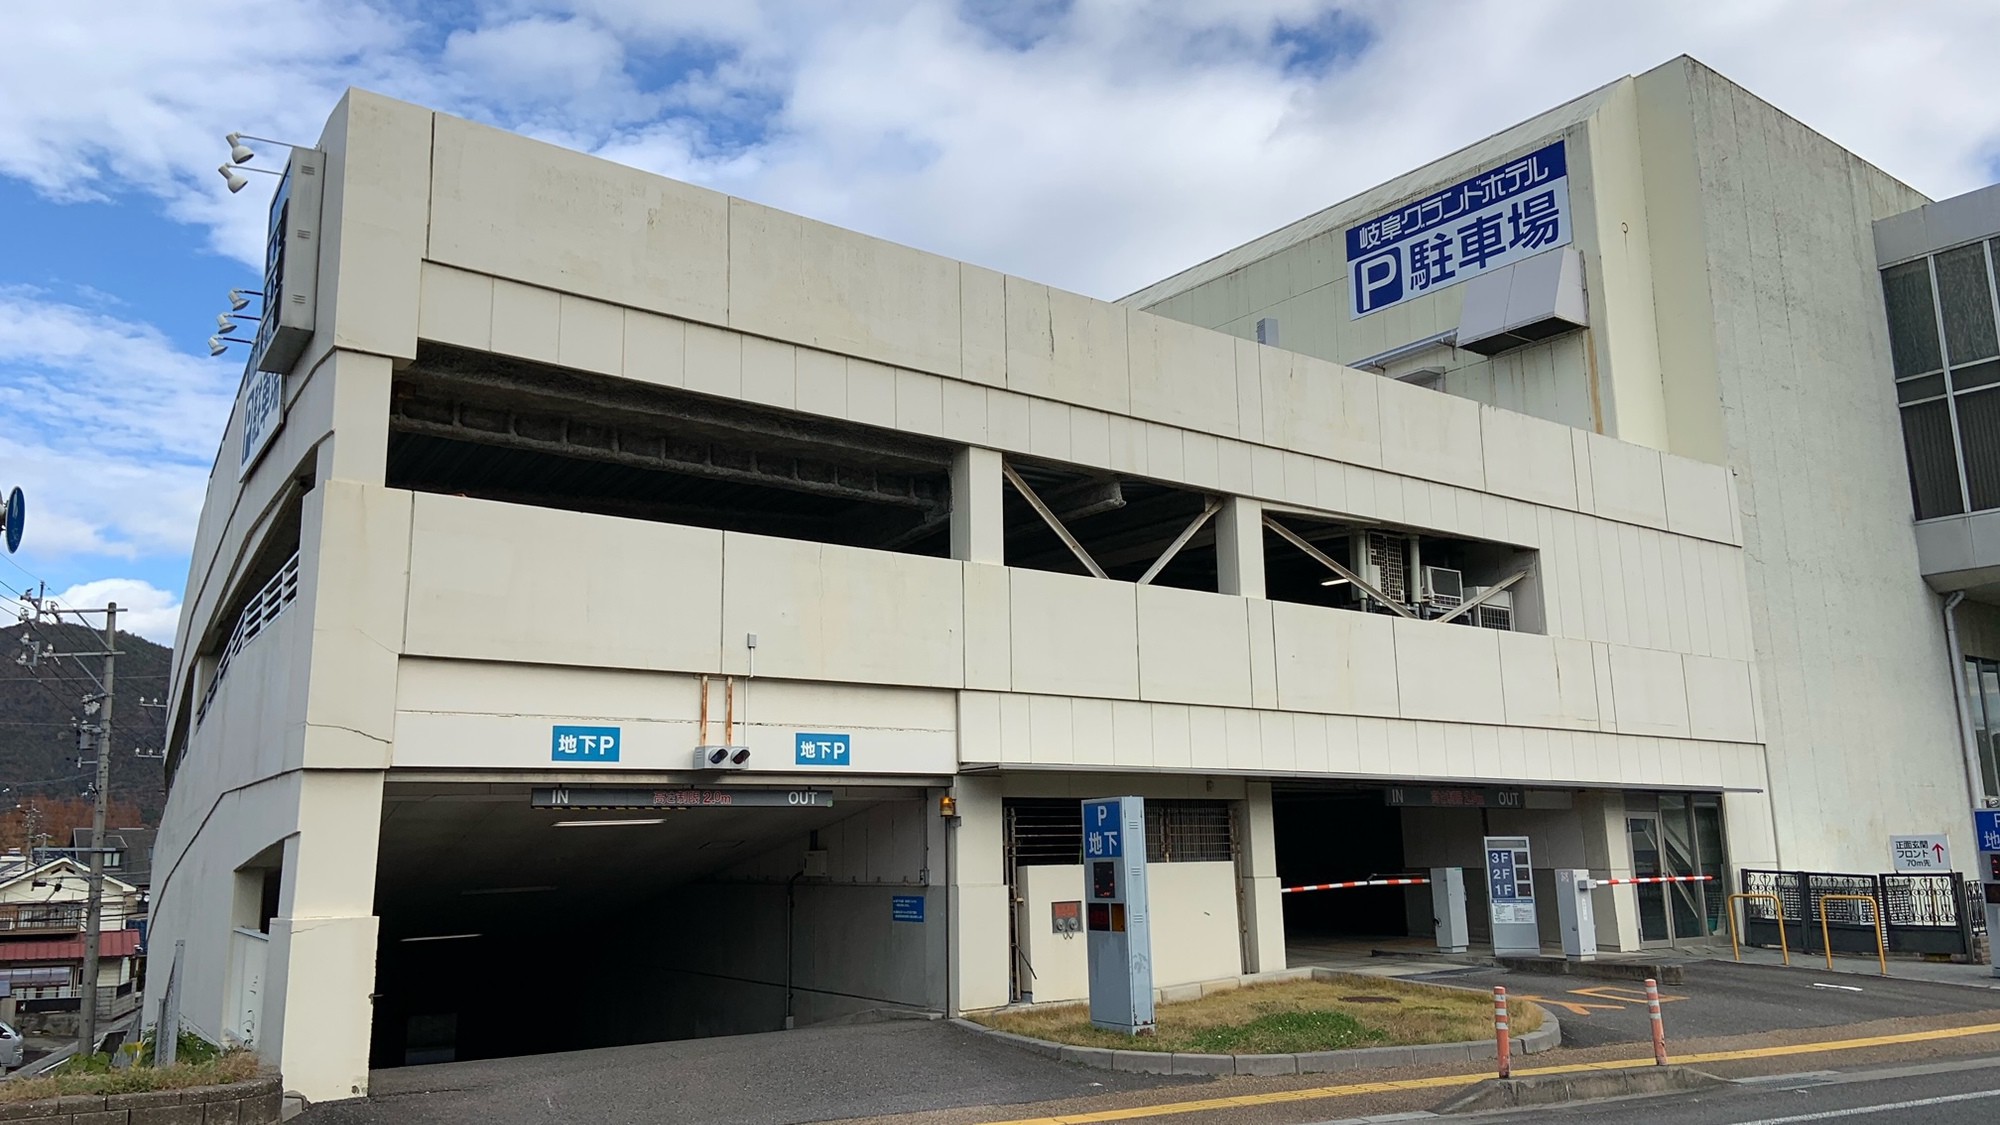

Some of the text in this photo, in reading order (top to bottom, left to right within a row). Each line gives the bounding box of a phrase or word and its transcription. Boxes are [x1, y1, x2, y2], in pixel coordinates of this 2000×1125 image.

[1358, 156, 1549, 250] 岐阜グランドホテル
[1409, 188, 1560, 291] 駐車場
[558, 734, 615, 755] 地下P
[800, 741, 846, 760] 地下P
[552, 789, 569, 804] IN
[788, 791, 817, 805] OUT
[1392, 789, 1404, 803] IN
[1498, 791, 1519, 806] OUT
[1097, 805, 1107, 826] P
[1089, 831, 1118, 855] 地下
[1491, 852, 1509, 864] 3F
[1896, 850, 1928, 858] フロント
[1493, 868, 1511, 880] 2F
[1495, 884, 1512, 895] 1F
